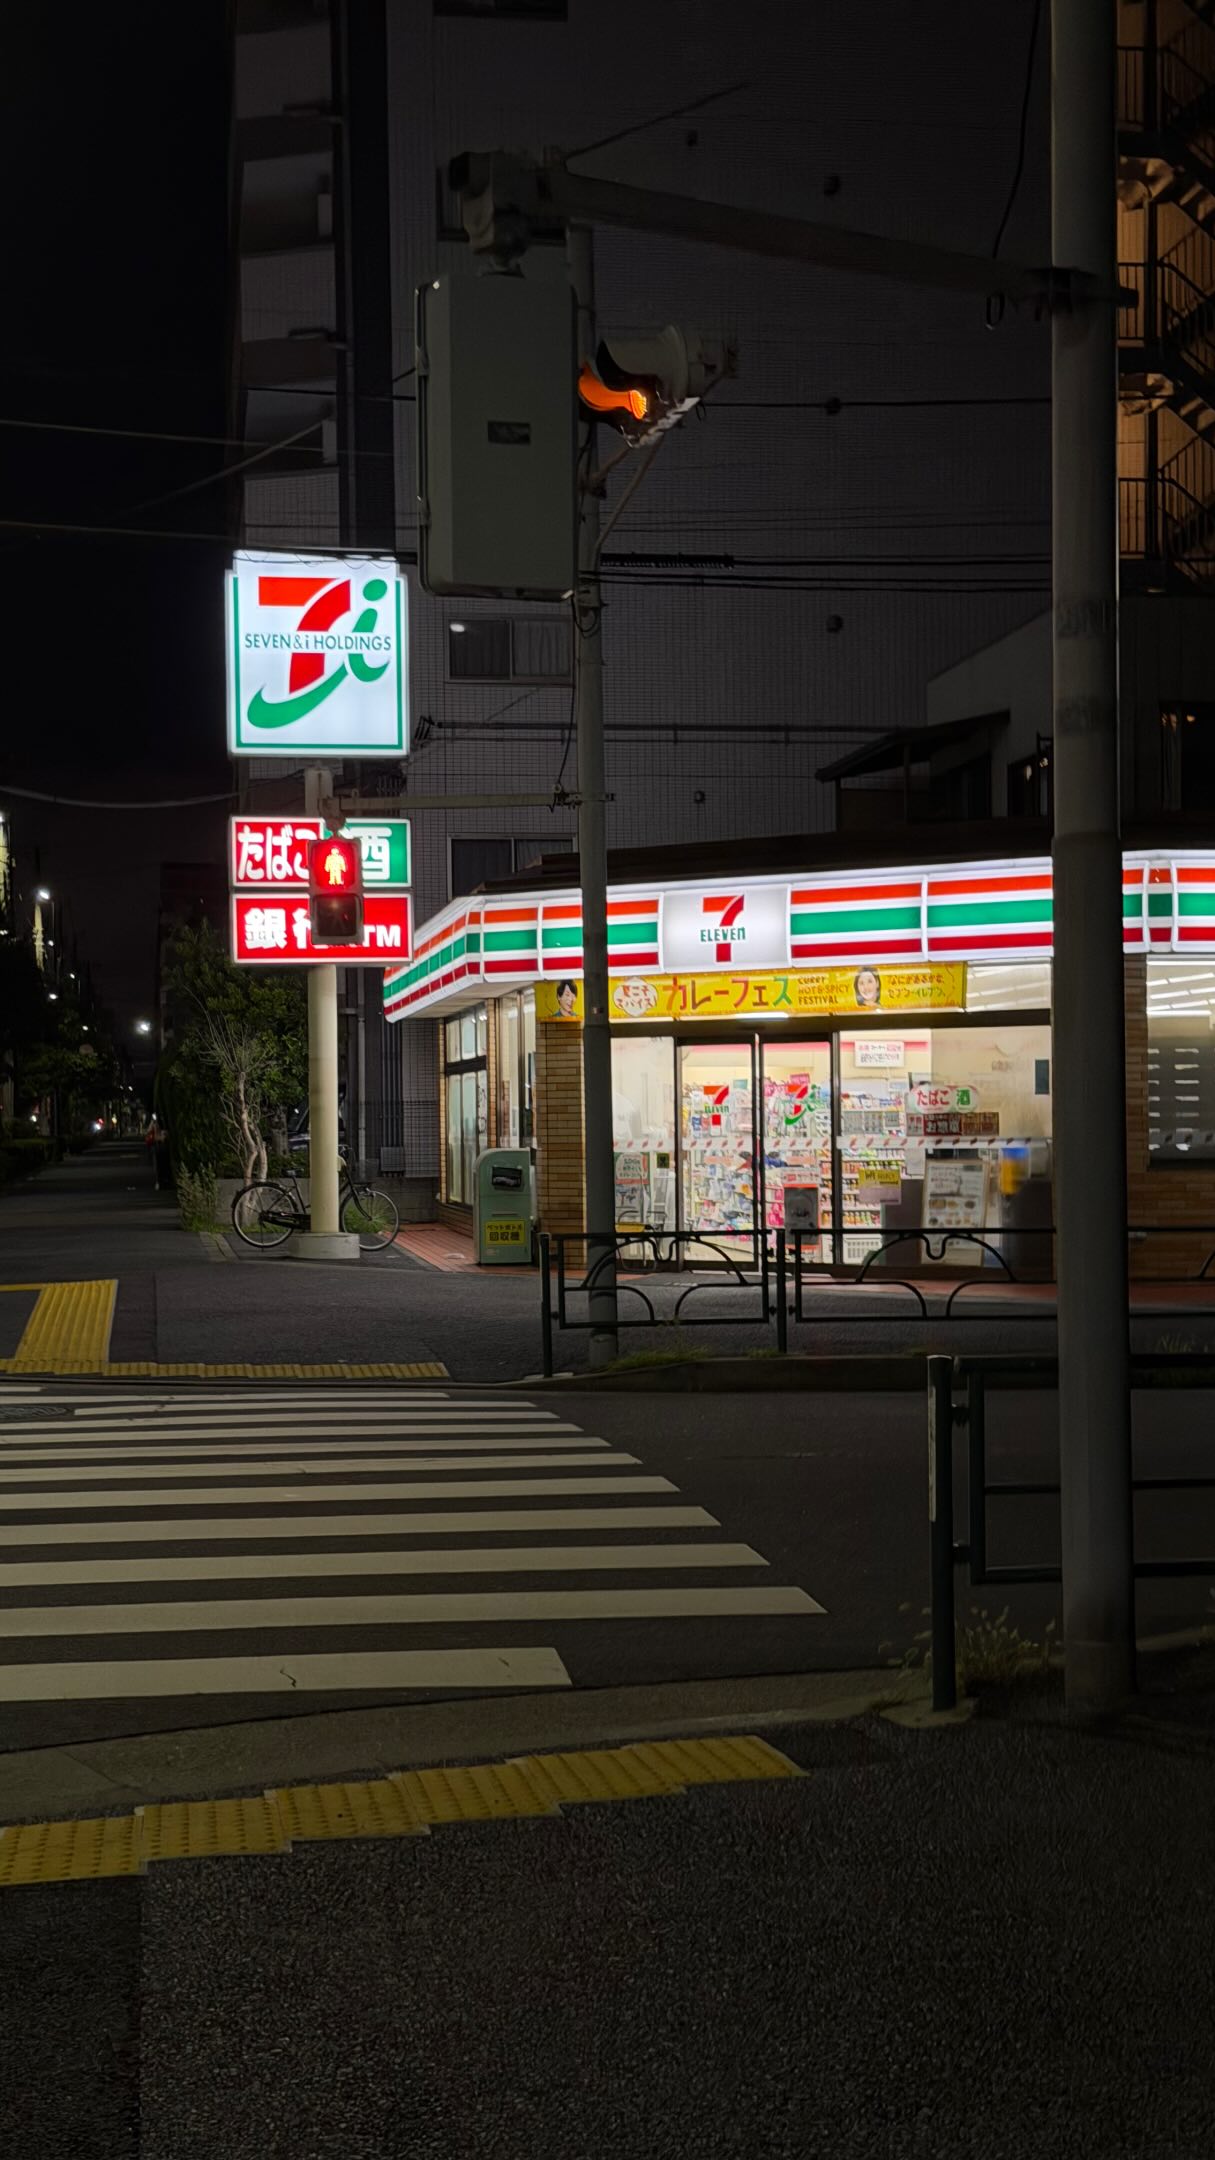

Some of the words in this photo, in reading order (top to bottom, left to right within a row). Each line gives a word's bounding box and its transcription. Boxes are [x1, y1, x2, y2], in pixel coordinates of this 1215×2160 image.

[314, 635, 391, 650] HOLDINGS
[662, 976, 792, 1011] カレーフェス
[798, 995, 838, 1006] FESTIVAL
[917, 1089, 950, 1106] たばこ
[956, 1089, 971, 1106] 酒
